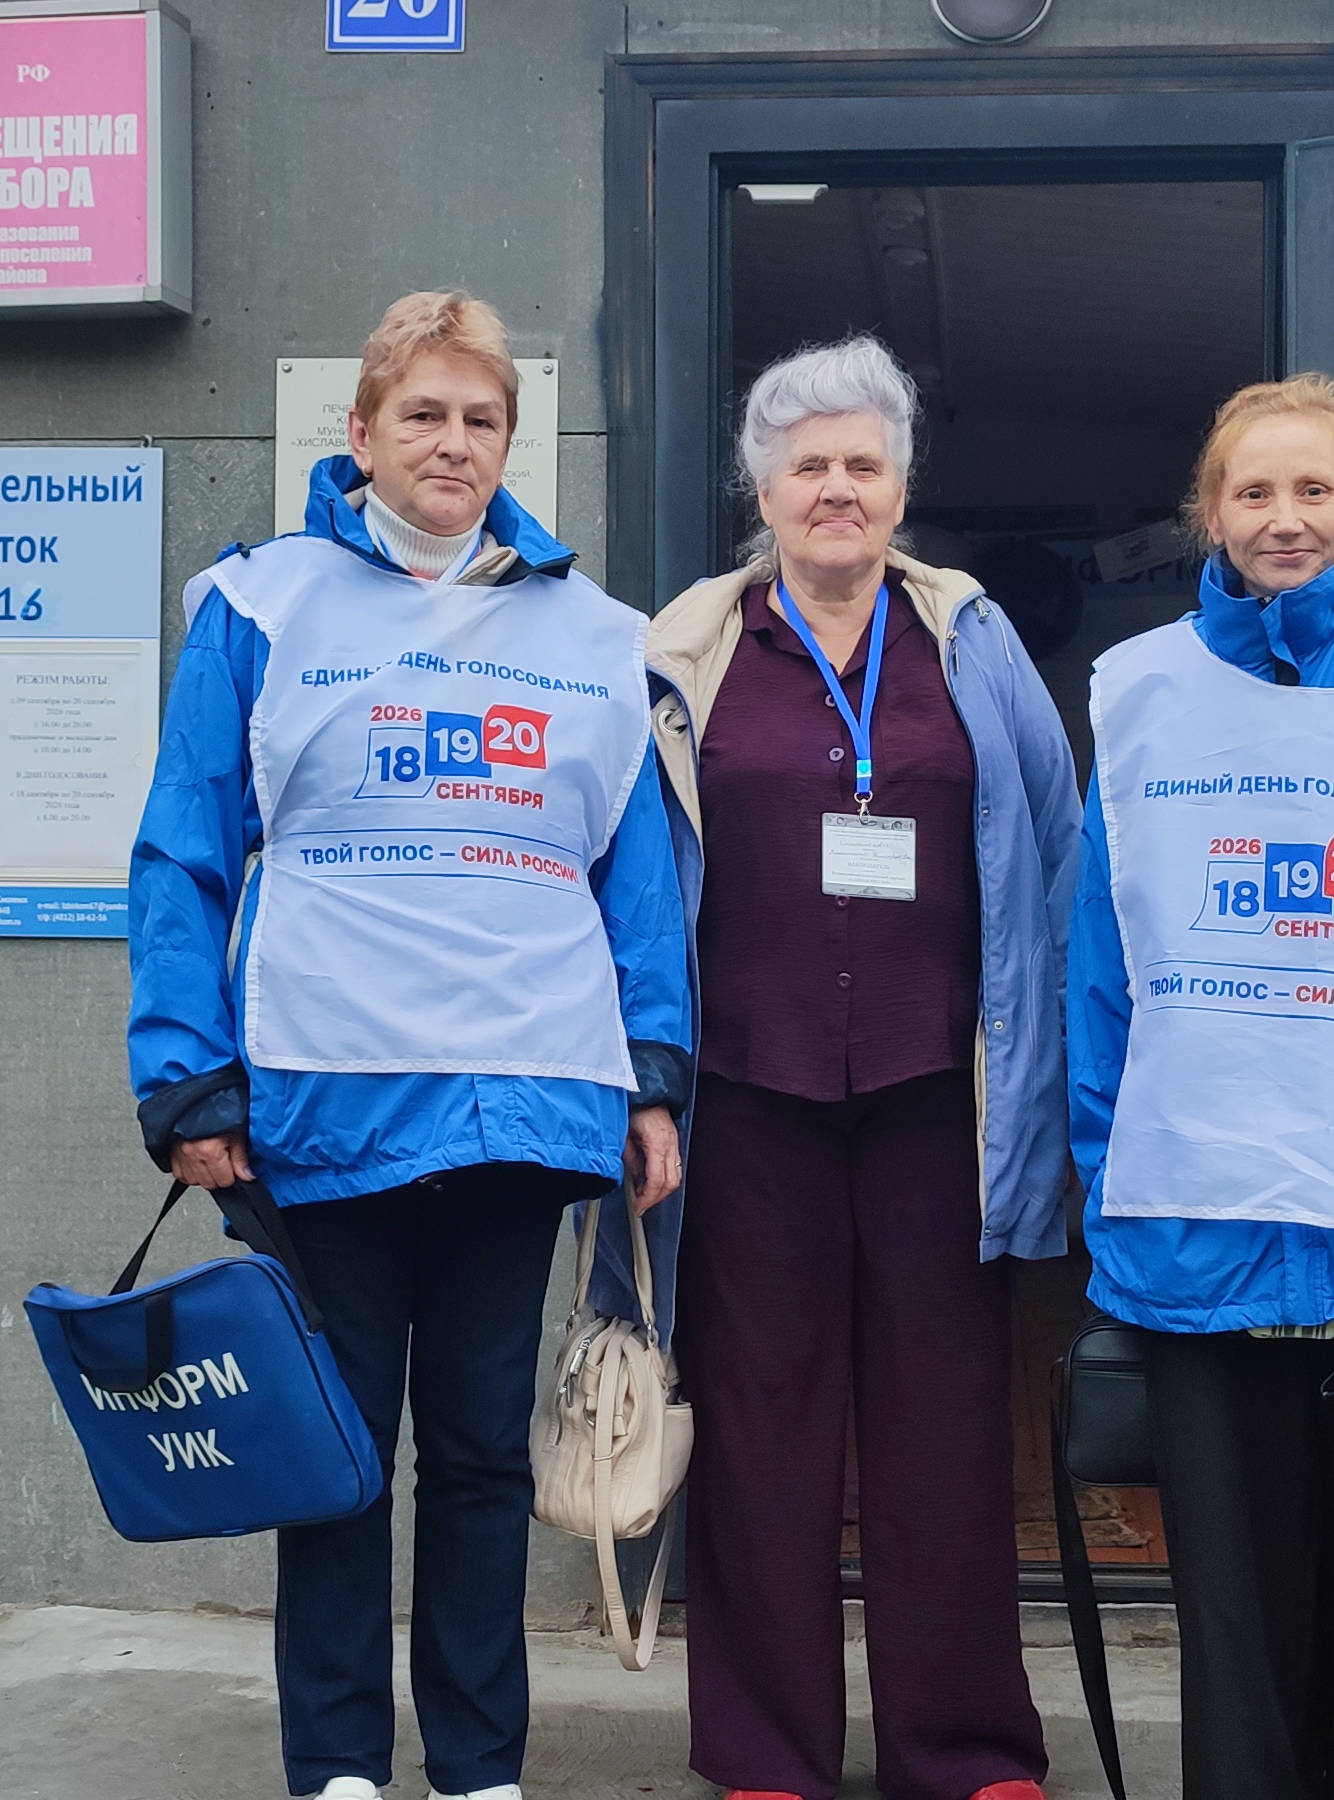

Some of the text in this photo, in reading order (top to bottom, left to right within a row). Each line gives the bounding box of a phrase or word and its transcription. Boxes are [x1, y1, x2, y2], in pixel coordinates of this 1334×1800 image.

[16, 63, 51, 83] РФ
[0, 246, 92, 264] поселения
[16, 674, 59, 685] РЕЖИМ
[397, 651, 452, 674] ДЕНЬ
[456, 661, 610, 700] ГОЛОСОВАНИЯ
[370, 705, 422, 722] 2026
[374, 718, 540, 782] 18 19 20
[436, 782, 544, 810] СЕНТЯБРЯ
[1144, 773, 1233, 799] ЕДИНЫЙ
[1237, 776, 1298, 796] ДЕНЬ
[300, 842, 353, 865] ТВОЙ
[359, 844, 434, 863] ГОЛОС
[460, 843, 517, 868] СИЛА
[1209, 838, 1262, 855] 2026
[1213, 880, 1260, 917] 18
[1271, 861, 1319, 898] 19
[1149, 973, 1183, 998] ТВОЙ
[1189, 978, 1268, 999] ГОЛОС
[146, 1428, 236, 1472] УИК
